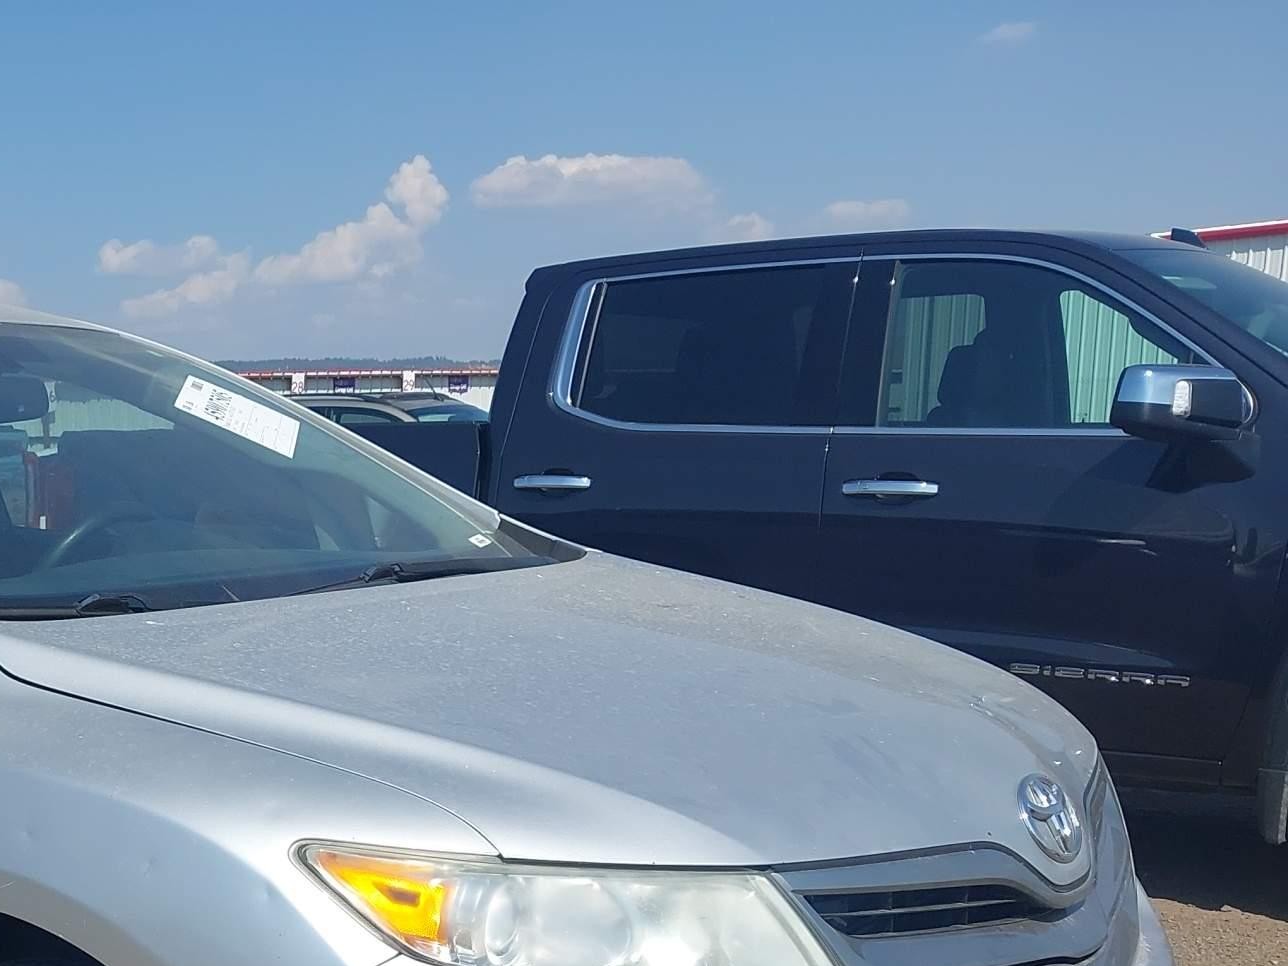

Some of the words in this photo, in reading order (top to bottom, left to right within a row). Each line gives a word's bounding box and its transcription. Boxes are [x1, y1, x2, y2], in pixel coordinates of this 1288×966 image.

[292, 381, 304, 394] 28
[402, 379, 415, 391] 29
[1009, 662, 1191, 688] SIERRA
